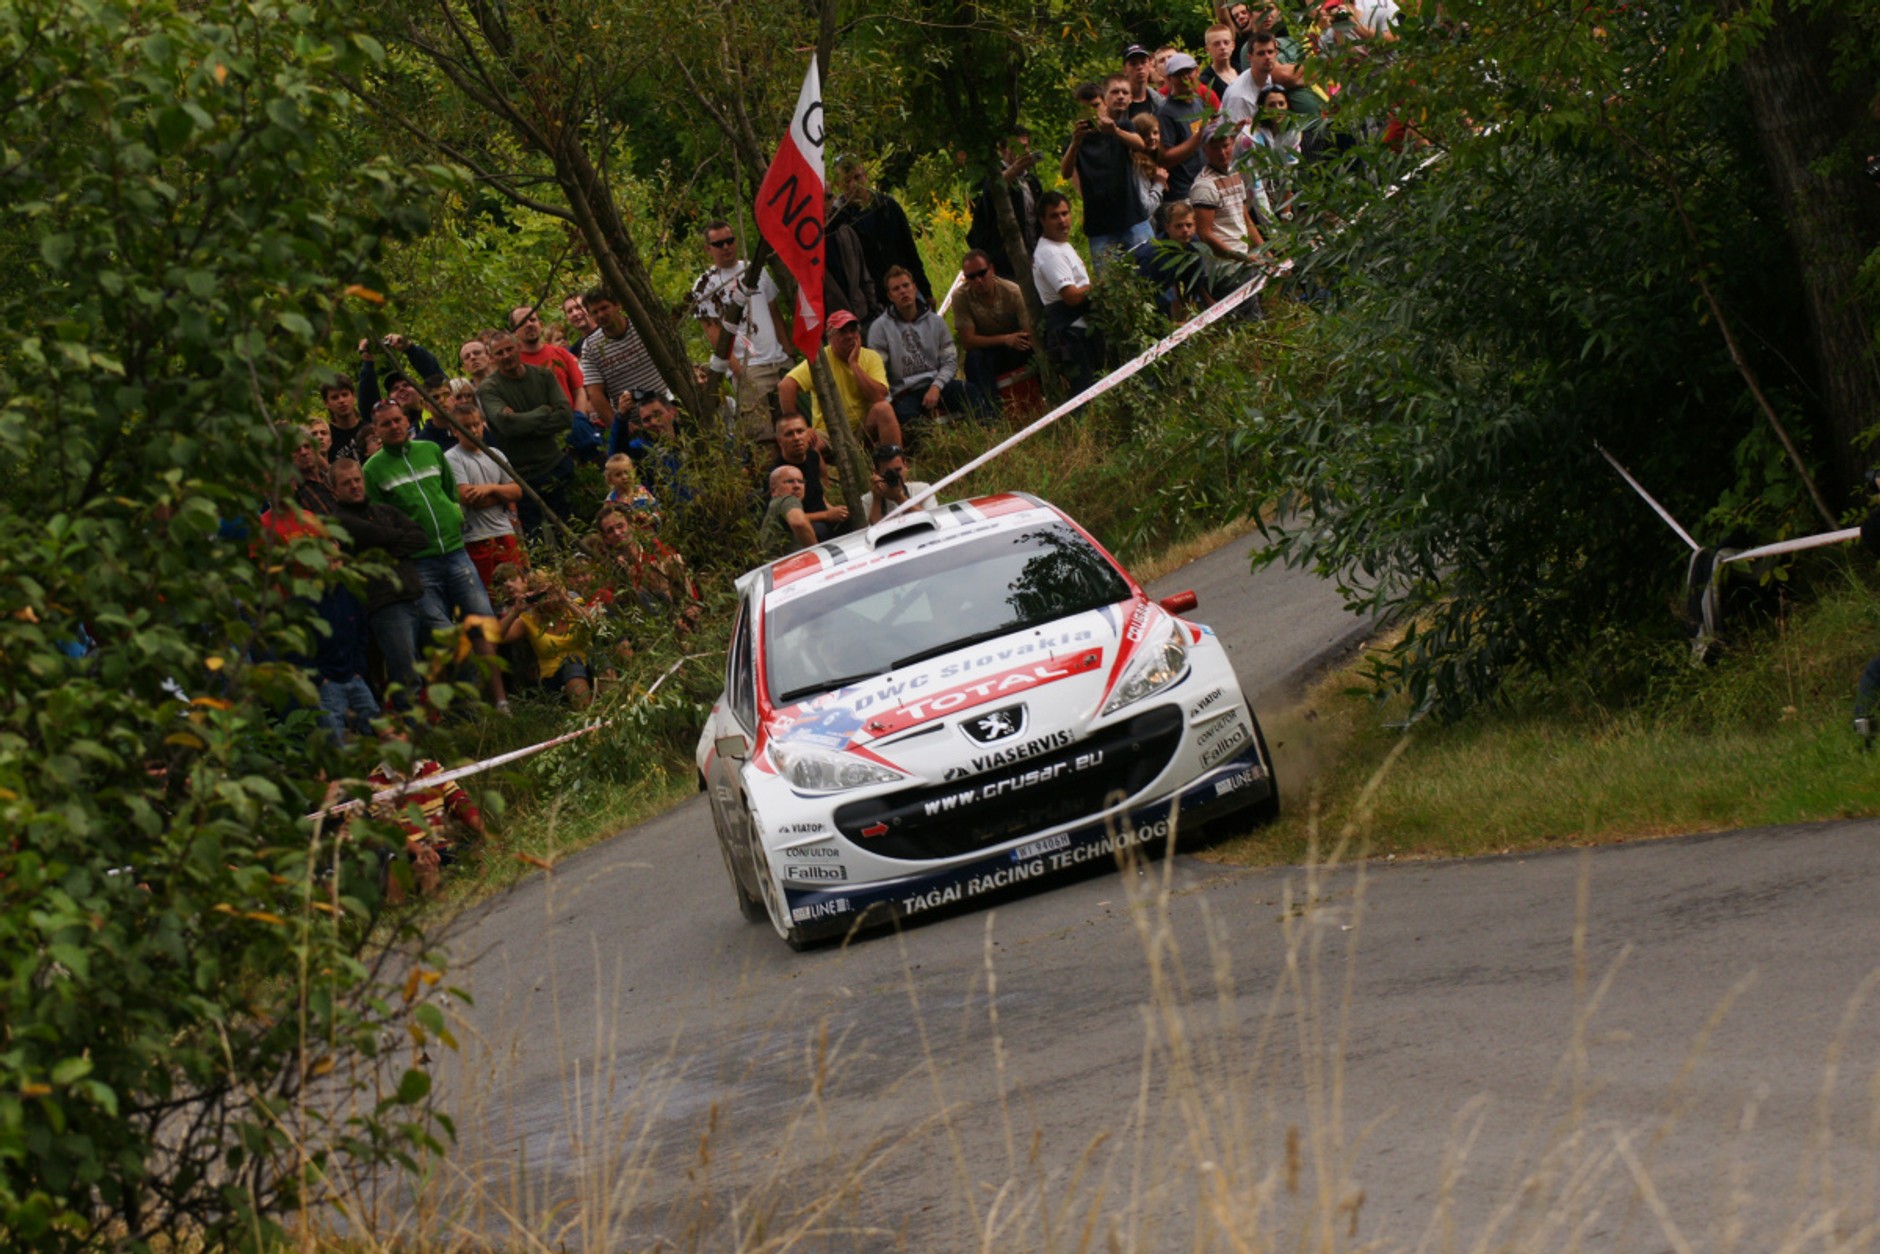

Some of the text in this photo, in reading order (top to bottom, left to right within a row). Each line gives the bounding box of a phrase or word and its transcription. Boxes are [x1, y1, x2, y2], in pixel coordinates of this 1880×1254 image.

[896, 665, 1069, 720] TOTAL
[971, 730, 1069, 772] VIASERVIS
[924, 750, 1103, 816] www.crusar.eu
[902, 884, 962, 915] TAGAI
[967, 860, 1045, 897] RACING
